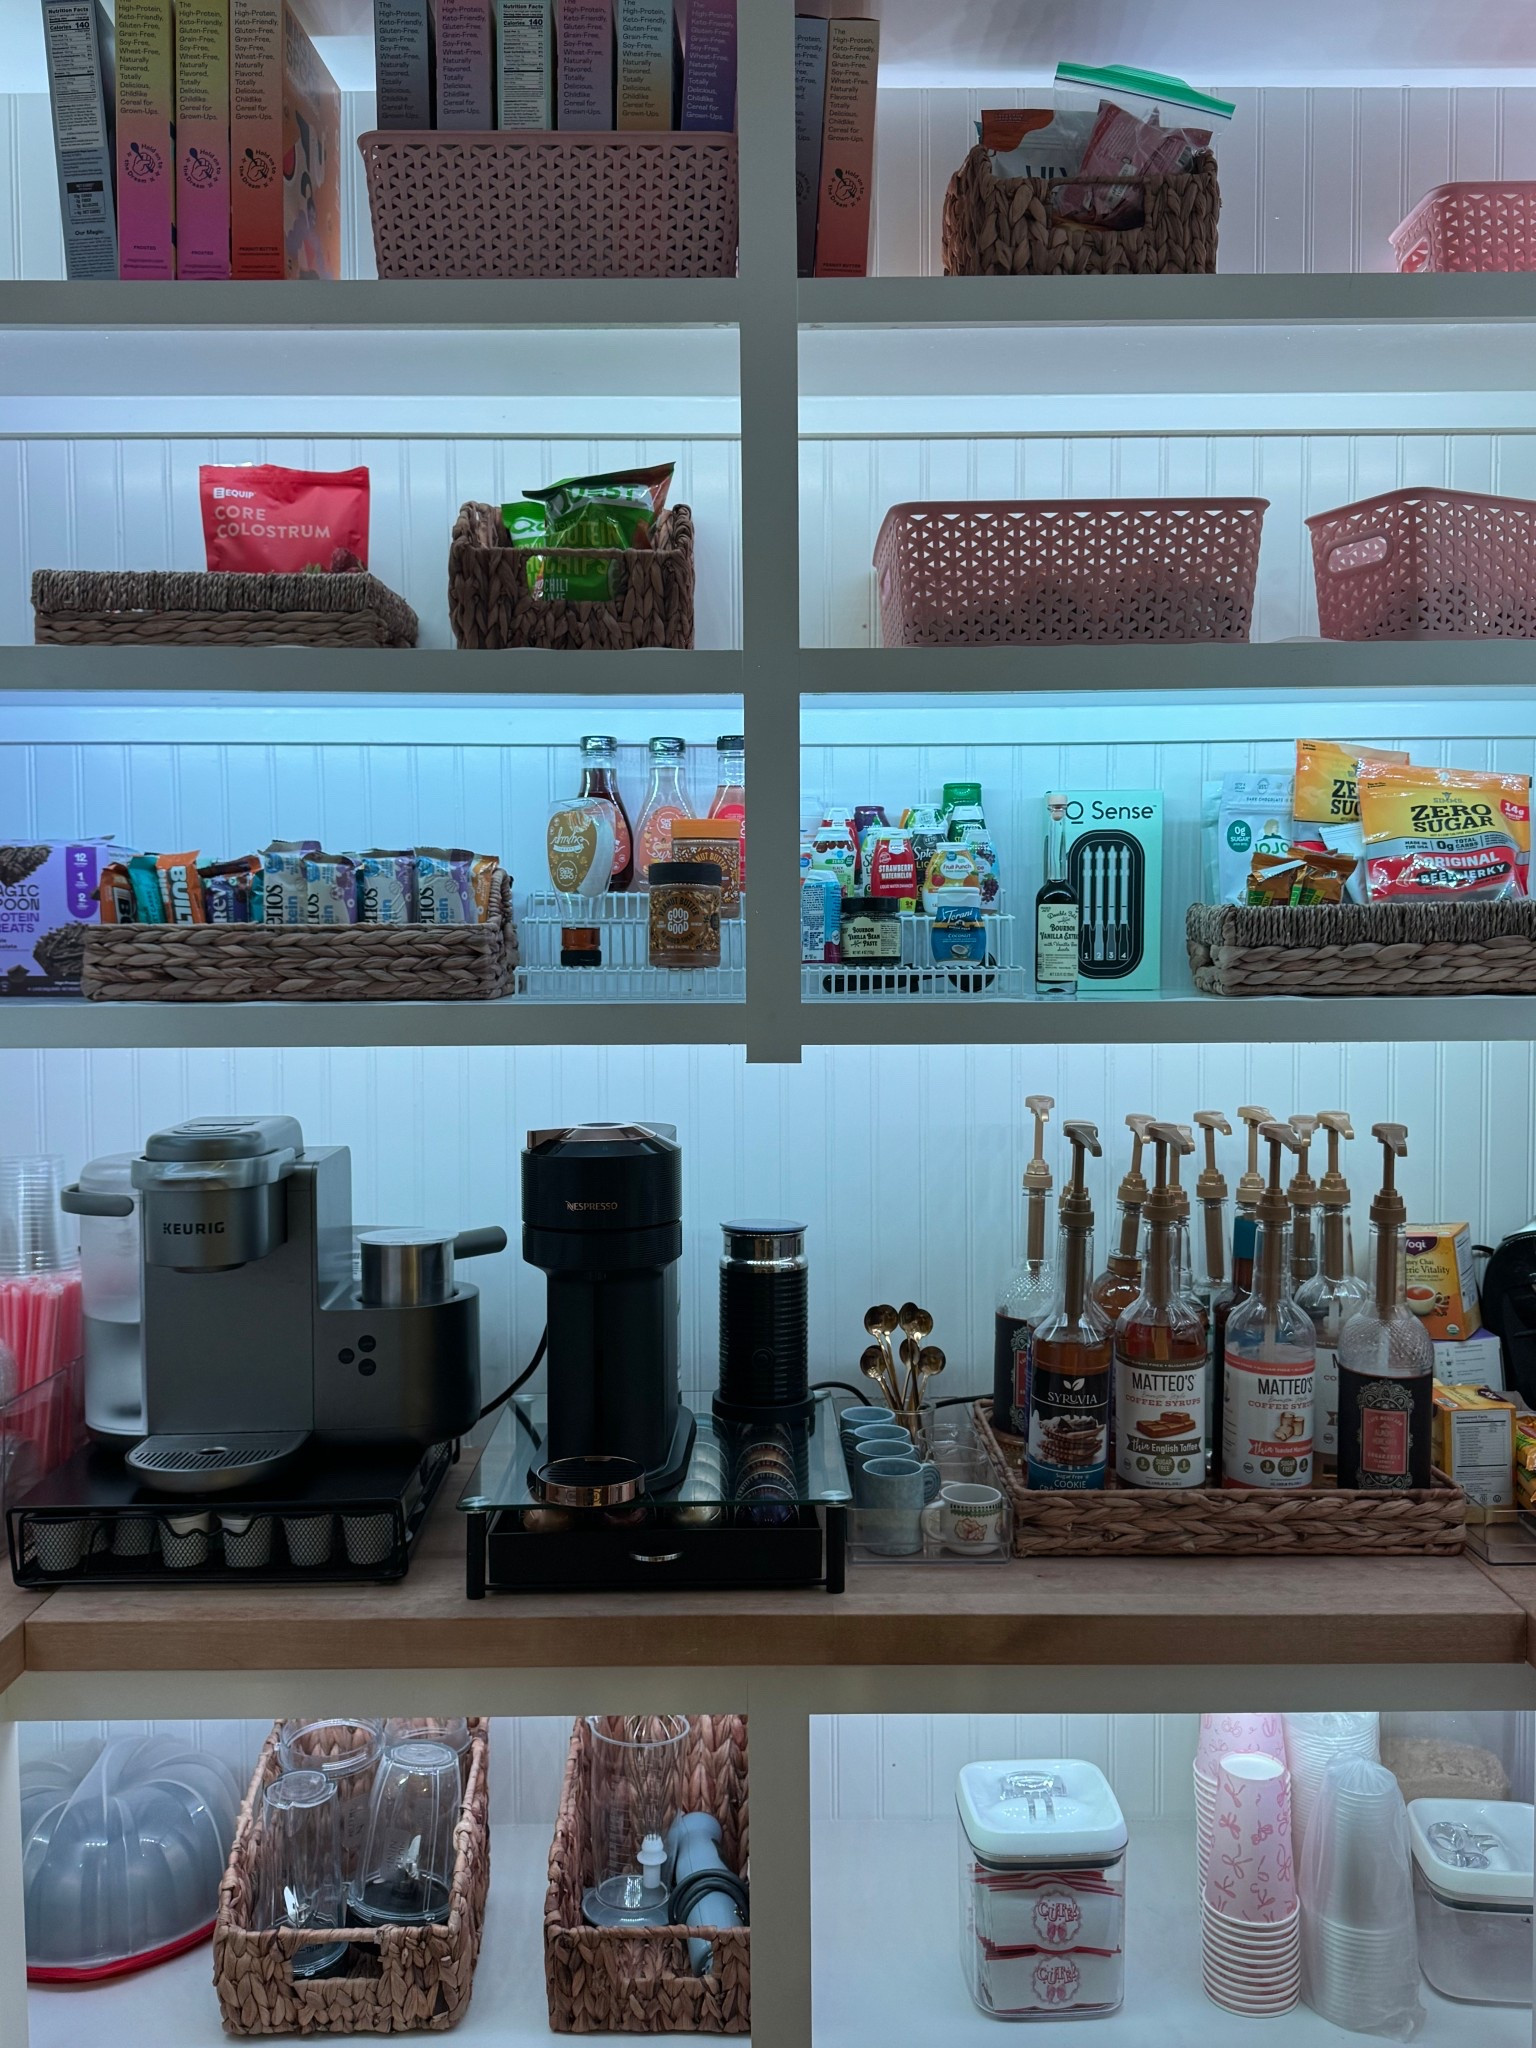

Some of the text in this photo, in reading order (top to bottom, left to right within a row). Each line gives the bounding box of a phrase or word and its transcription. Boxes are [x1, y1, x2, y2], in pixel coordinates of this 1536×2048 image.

[226, 489, 254, 499] EQUIP
[215, 506, 266, 521] CORE
[217, 522, 330, 539] COLOSTRUM
[544, 578, 568, 592] CHILI
[1332, 779, 1358, 799] ZE
[1411, 805, 1491, 820] ZERO
[1505, 802, 1524, 815] 14g
[1234, 826, 1246, 836] 0g
[1414, 816, 1495, 833] SUGAR
[1436, 840, 1454, 851] 0g
[74, 852, 87, 862] 12
[647, 842, 672, 863] Syr
[913, 846, 934, 861] Sple
[710, 852, 727, 871] BUTTER
[1424, 852, 1499, 868] ORIGINAL
[879, 864, 914, 873] STRAWBERRY
[77, 872, 84, 881] 1
[78, 893, 86, 902] 2
[170, 866, 194, 924] BUILT
[0, 898, 40, 910] OON
[266, 884, 283, 924] erios
[660, 896, 699, 916] PEANUT BUTTER
[0, 912, 39, 922] OTEIN
[668, 908, 688, 920] GOOD
[945, 908, 973, 924] Torani
[0, 923, 34, 933] EATS
[668, 921, 688, 934] GOOD
[1040, 932, 1063, 940] VANILLA
[565, 1201, 618, 1212] NESPRESSO
[163, 1222, 224, 1235] KEURIG
[1421, 1266, 1450, 1276] Vitality
[1132, 1372, 1195, 1392] MATTEO'S
[1258, 1377, 1313, 1395] MATTEO'S
[1048, 1392, 1097, 1405] SYRUVIA
[1126, 1394, 1162, 1407] COFFEE
[1165, 1397, 1201, 1407] SYRUPS
[1248, 1400, 1288, 1410] COFFEE
[1151, 1443, 1198, 1454] English Toffee
[1054, 1480, 1086, 1489] COOKIE
